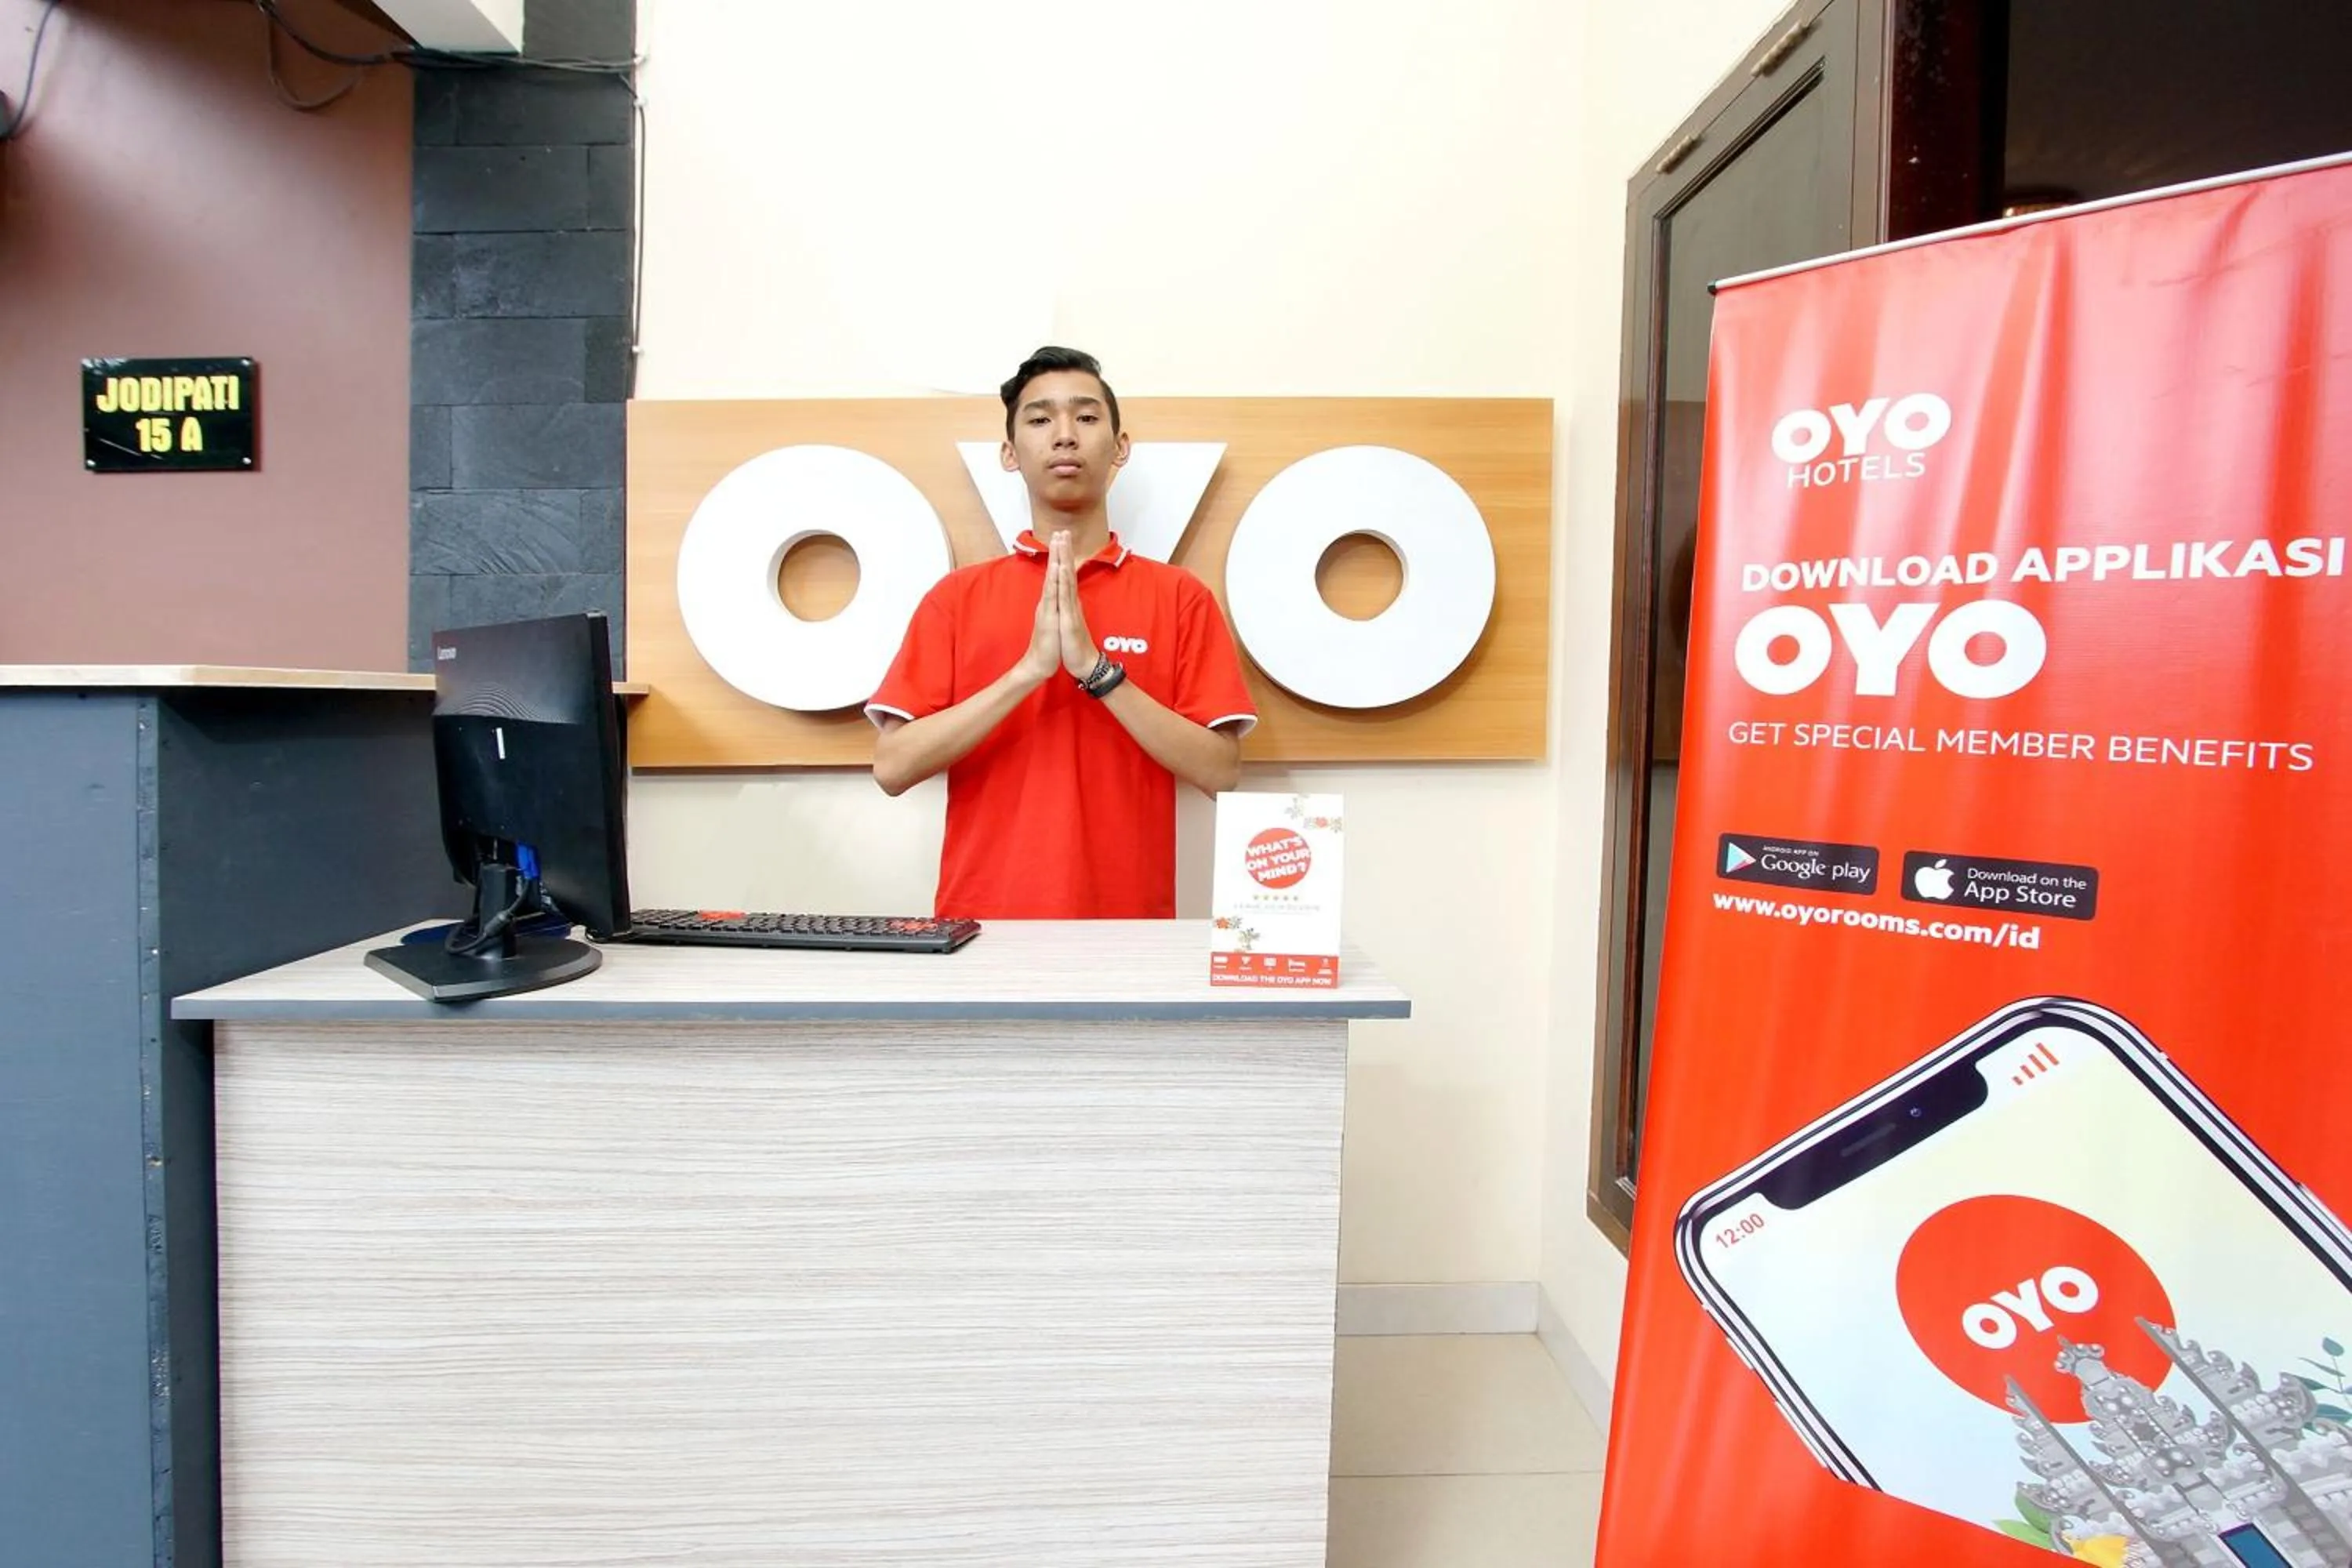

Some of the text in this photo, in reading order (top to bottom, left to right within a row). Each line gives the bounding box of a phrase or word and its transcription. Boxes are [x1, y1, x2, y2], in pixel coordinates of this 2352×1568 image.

[96, 376, 239, 413] JODIPATI
[135, 416, 203, 452] 15 A
[1772, 393, 1951, 464] OYO
[1787, 452, 1926, 489] HOTELS
[1741, 537, 2346, 593] DOWNLOAD APPLIKASI
[1103, 636, 1149, 655] OYO
[1734, 599, 2048, 699] OYO
[1728, 721, 2314, 771] GET SPECIAL MEMBER BENEFITS
[1246, 837, 1304, 858] WHAT'S
[1247, 848, 1312, 871] ON YOUR
[1761, 854, 1871, 884] Google play
[1967, 867, 2088, 890] Download on the
[1964, 880, 2077, 908] App Store
[1712, 891, 2042, 950] www.oyorooms.com/id
[1715, 1213, 1766, 1248] 12:00
[1962, 1266, 2099, 1349] OYO
